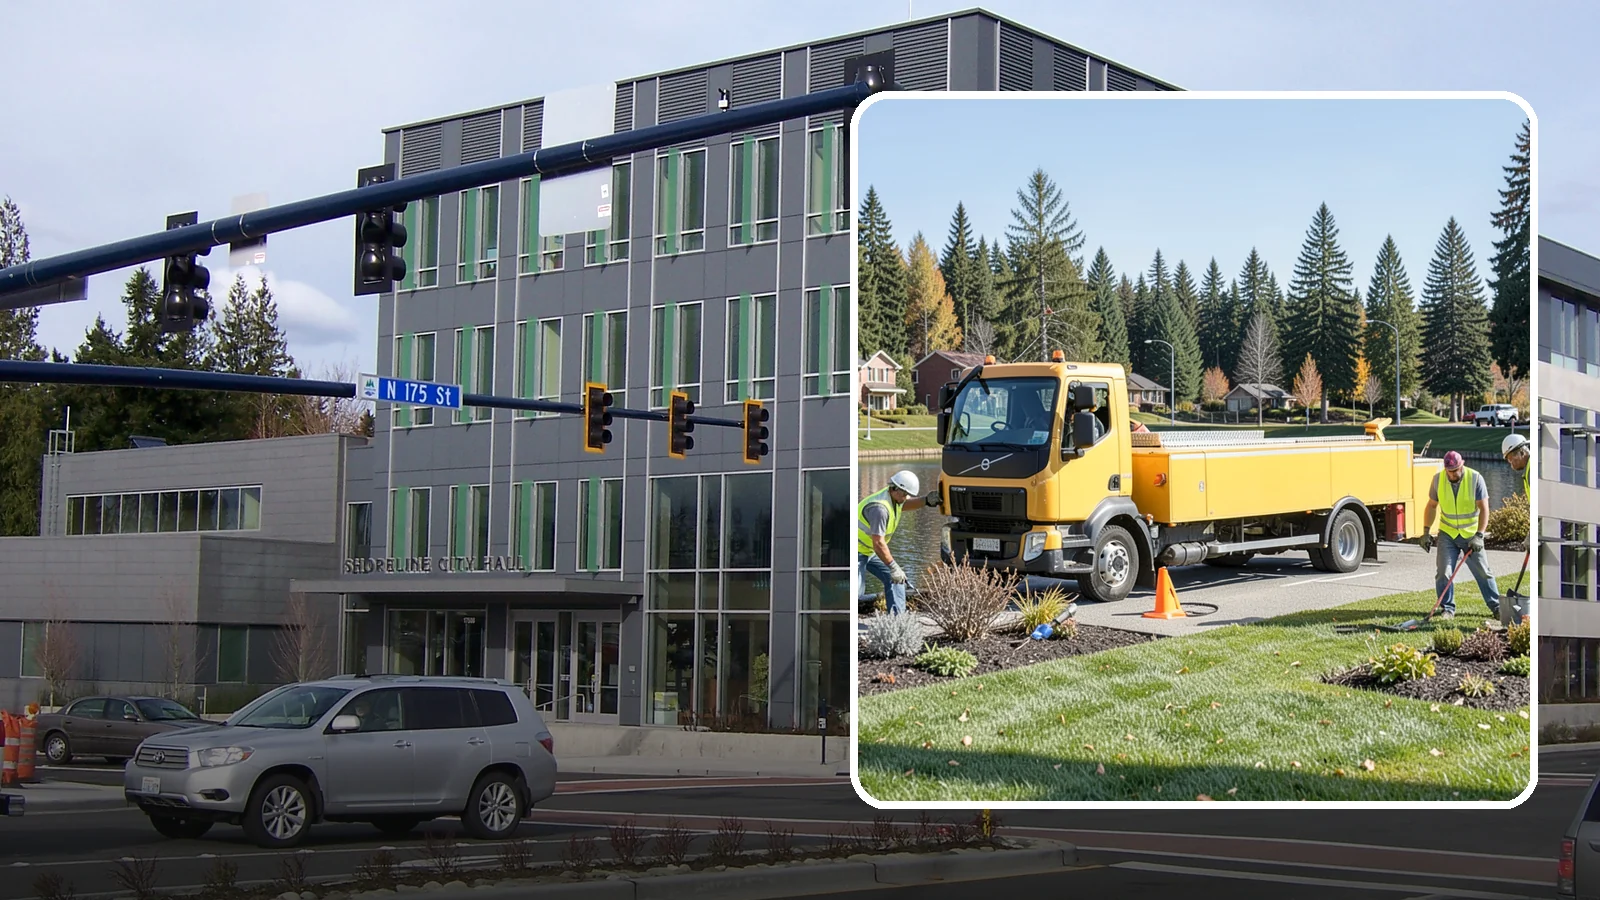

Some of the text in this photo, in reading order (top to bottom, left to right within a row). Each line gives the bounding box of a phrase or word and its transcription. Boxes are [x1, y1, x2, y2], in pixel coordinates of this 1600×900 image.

[387, 381, 451, 405] N 175 St
[344, 555, 525, 574] SHORELINE CITY HALL
